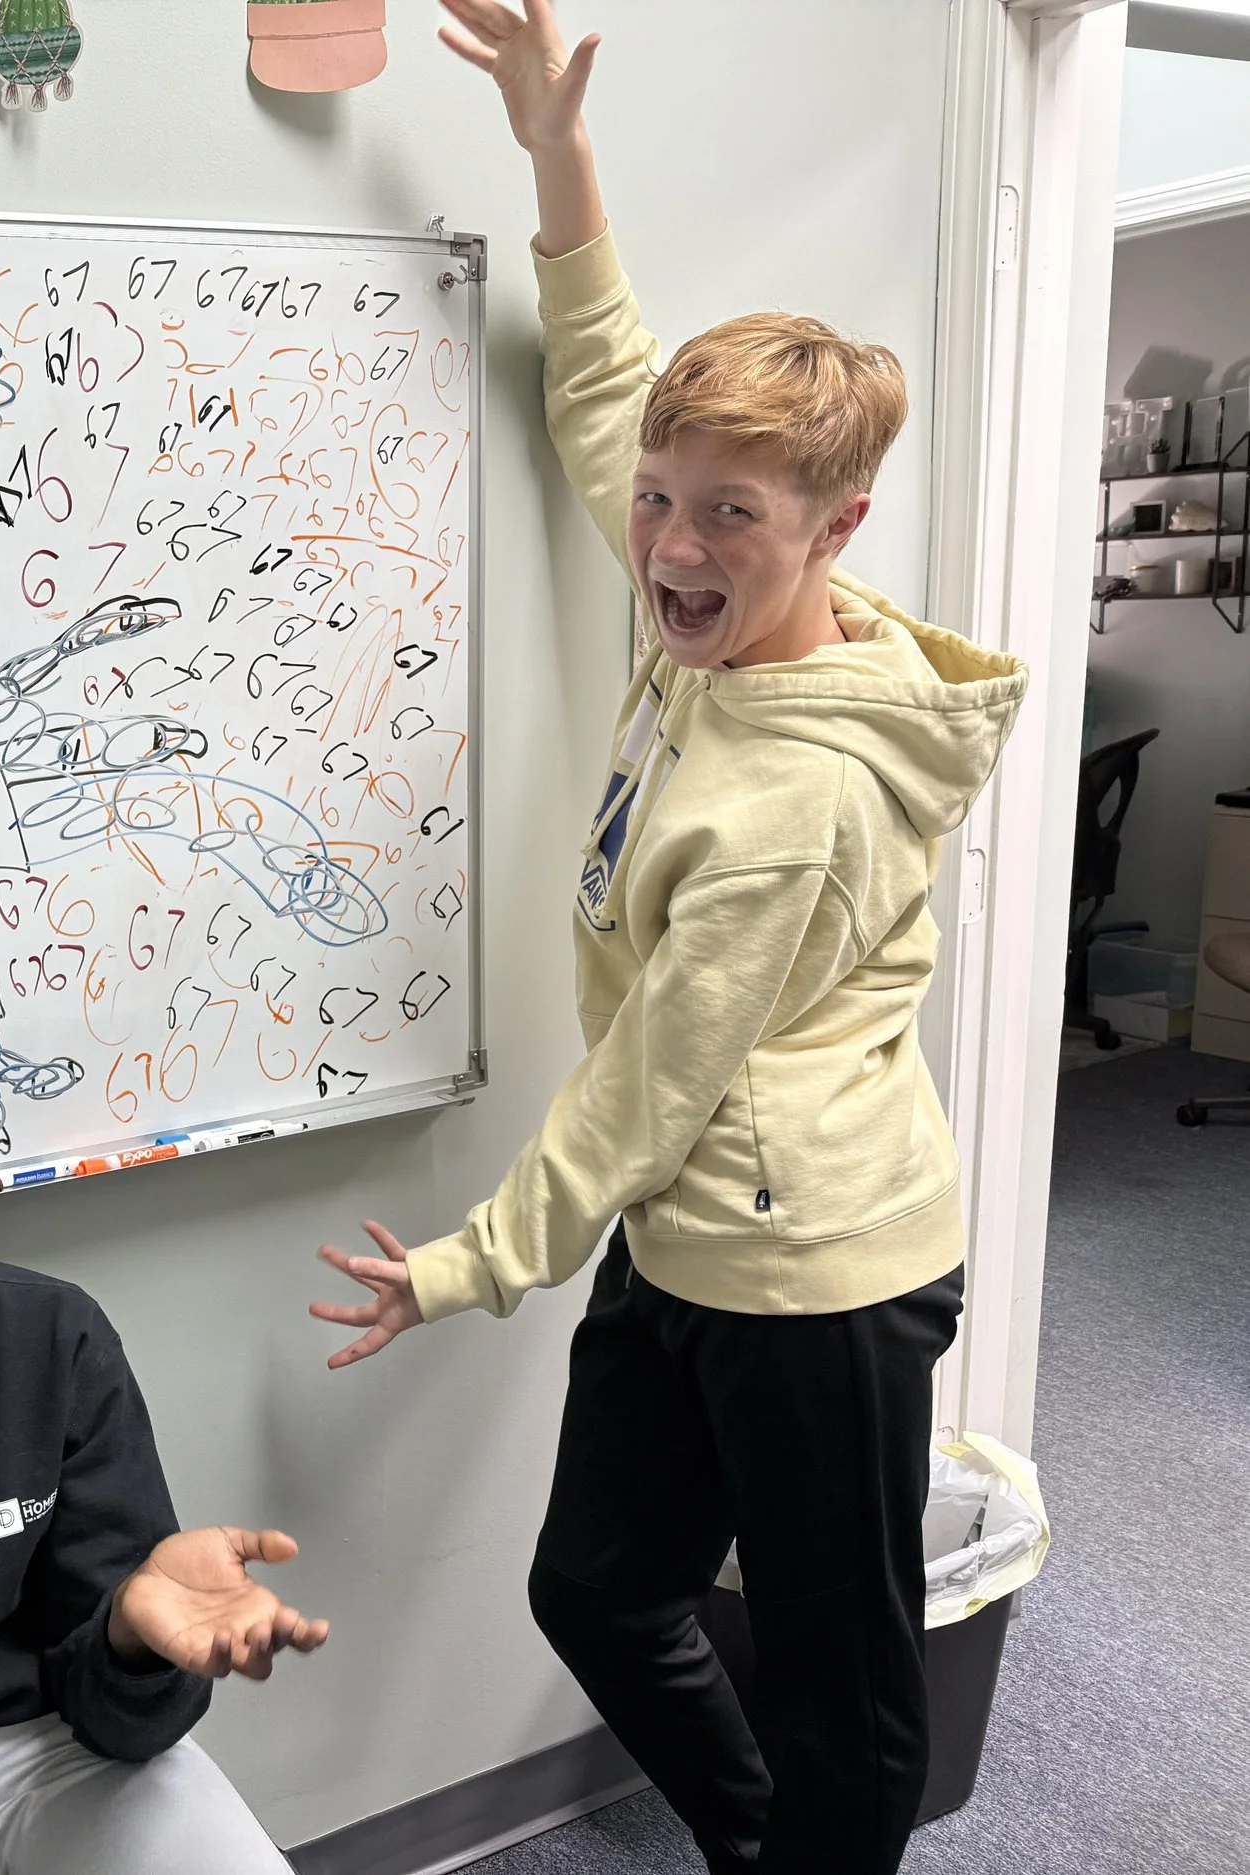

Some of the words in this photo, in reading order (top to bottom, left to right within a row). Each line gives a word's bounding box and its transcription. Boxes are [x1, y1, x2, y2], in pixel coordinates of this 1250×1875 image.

[45, 261, 89, 307] 67
[129, 257, 177, 299] 67
[197, 267, 248, 308] 67
[282, 276, 321, 318] 67
[242, 281, 279, 317] 67
[354, 284, 400, 318] 67
[371, 346, 409, 380] 67
[85, 403, 121, 449] 67
[159, 423, 182, 453] 67
[378, 436, 403, 464] 67
[35, 428, 130, 527] 67
[137, 500, 184, 535] 67
[208, 490, 246, 527] 67
[166, 524, 242, 562] 67
[249, 543, 292, 574] 67
[21, 542, 126, 607] 67
[294, 569, 332, 595] 67
[209, 588, 274, 624] 67
[433, 605, 461, 629] 67
[274, 614, 316, 647] 67
[123, 657, 193, 698] 67
[188, 646, 235, 683] 67
[247, 654, 316, 699] 67
[394, 644, 437, 679] 67
[84, 667, 126, 709] 67
[291, 685, 333, 722] 67
[390, 707, 434, 740] 67
[253, 726, 287, 765] 67
[322, 742, 368, 780] 67
[128, 904, 185, 970] 67
[207, 904, 252, 958] 67
[10, 955, 41, 996] 67
[43, 944, 85, 990] 67
[251, 957, 296, 1000] 67
[167, 977, 211, 1031] 67
[320, 988, 378, 1029] 67
[399, 971, 451, 1020] 67
[107, 1052, 151, 1122] 67
[122, 1149, 153, 1166] EXPO
